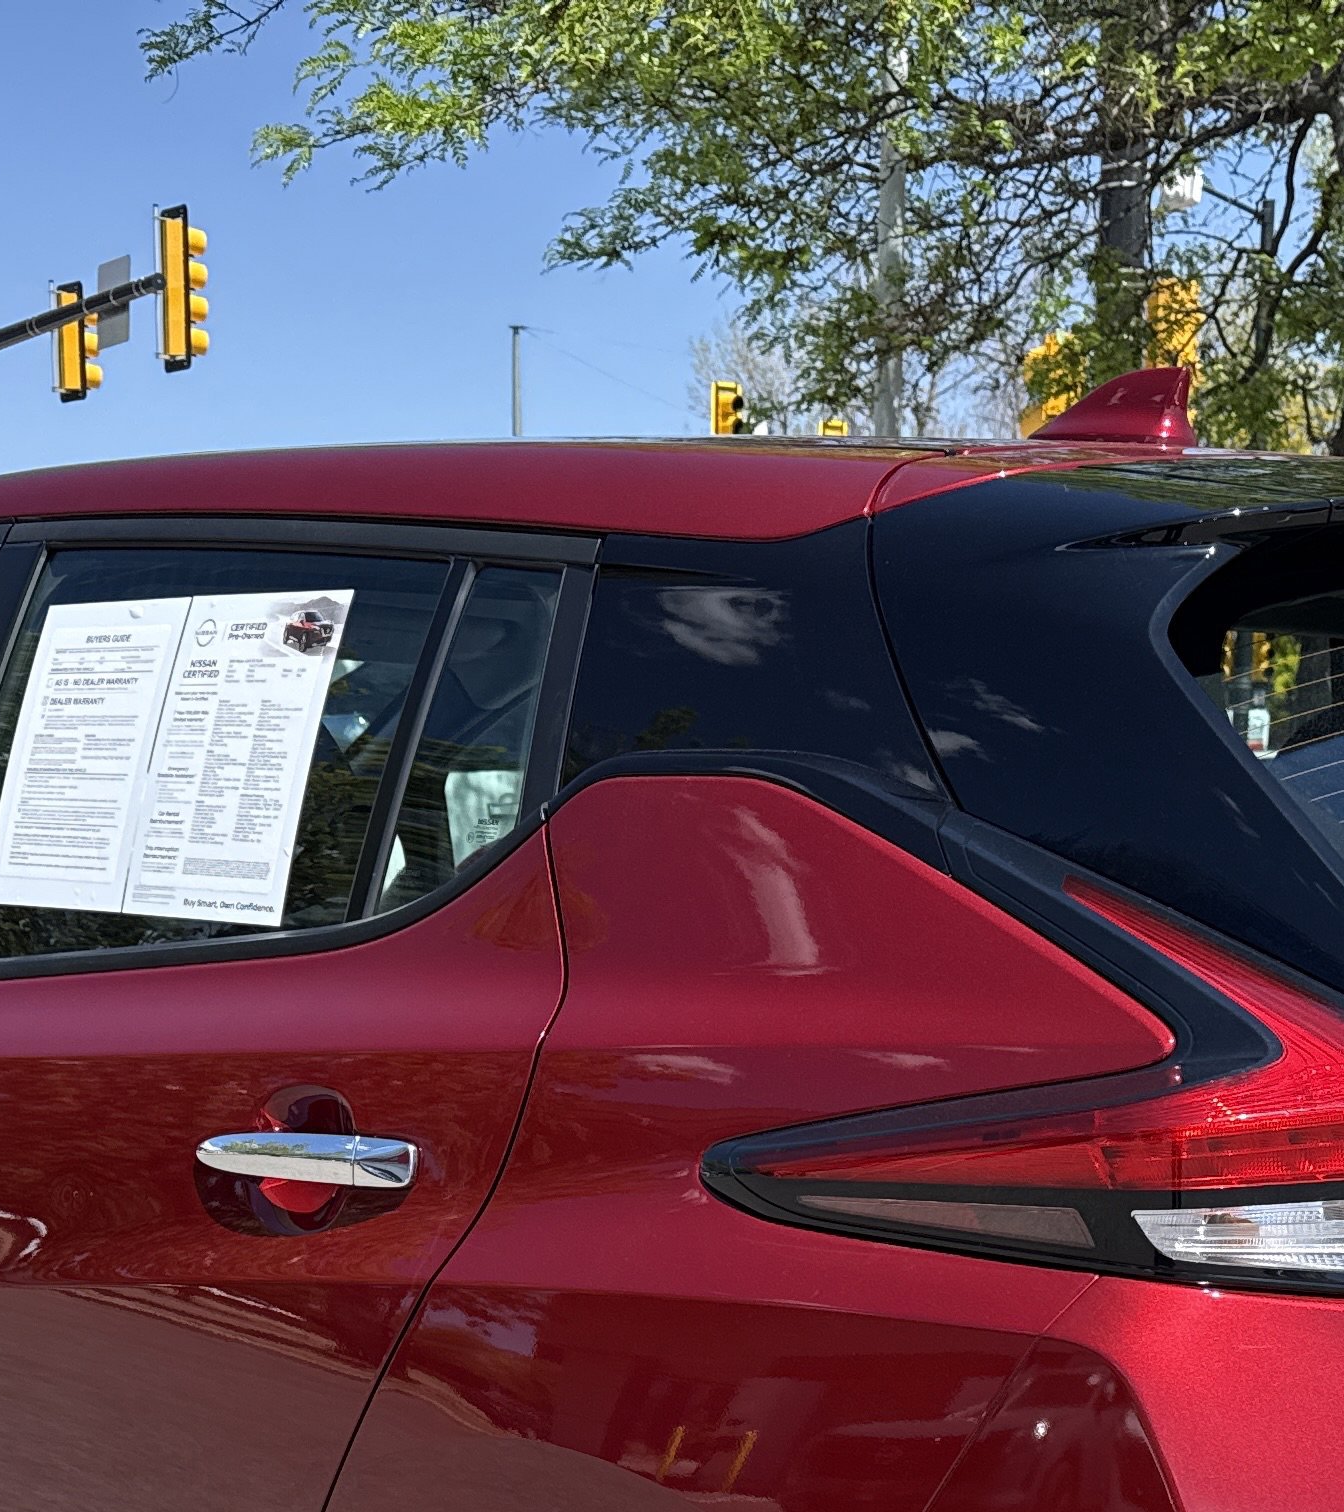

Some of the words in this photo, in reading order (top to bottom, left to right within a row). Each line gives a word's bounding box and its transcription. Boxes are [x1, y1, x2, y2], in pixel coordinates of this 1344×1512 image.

[230, 622, 268, 631] CERTIFIED
[111, 633, 132, 642] GUIDE
[227, 632, 265, 641] Pre-Owned
[190, 659, 218, 668] NISSAN
[182, 670, 220, 679] CERTIFIED
[82, 678, 105, 686] DEALER
[105, 677, 139, 686] WARRANTY
[49, 697, 72, 706] DEALER
[72, 697, 105, 706] WARRANTY
[183, 899, 197, 909] Buy
[235, 902, 275, 913] Confidence.
